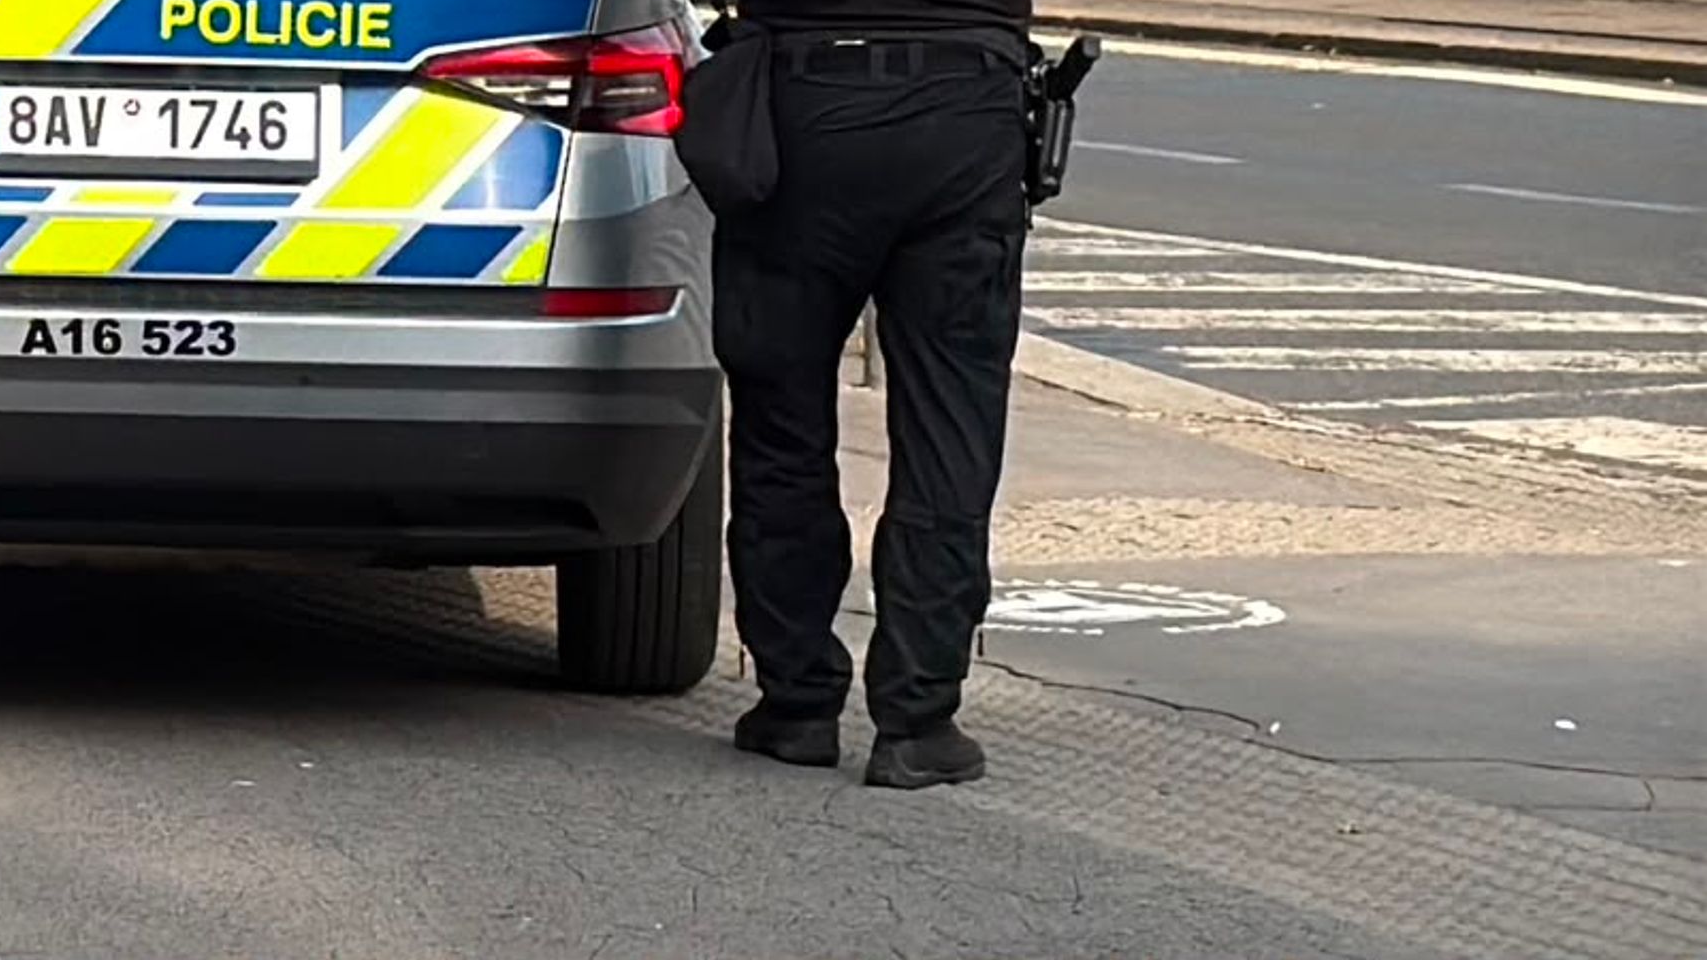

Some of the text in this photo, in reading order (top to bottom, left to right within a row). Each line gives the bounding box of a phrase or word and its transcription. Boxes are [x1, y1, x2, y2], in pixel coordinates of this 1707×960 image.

[9, 96, 288, 151] 8AV 1746
[21, 319, 236, 356] A16 523
